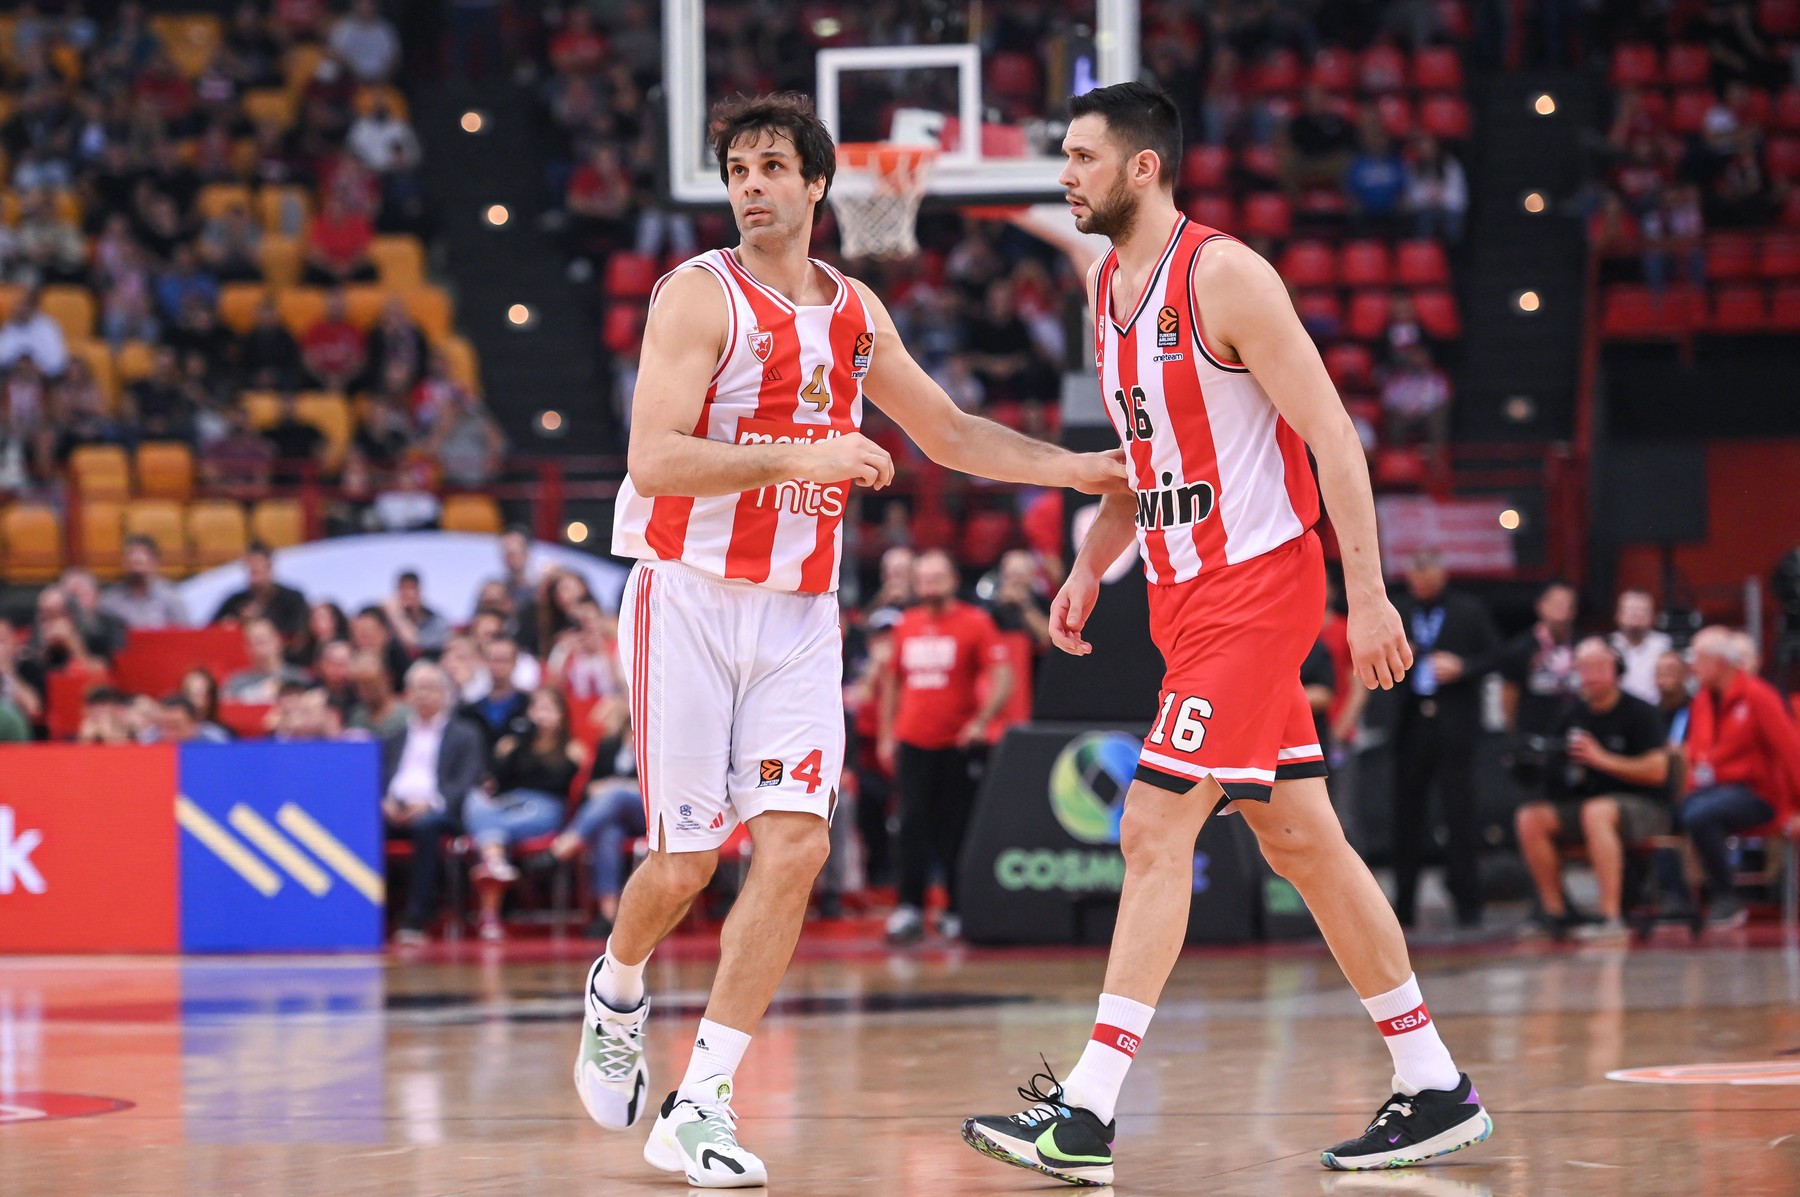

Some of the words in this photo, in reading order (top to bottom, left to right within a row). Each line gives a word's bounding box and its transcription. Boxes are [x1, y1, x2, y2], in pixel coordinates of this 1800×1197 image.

[1153, 353, 1183, 362] oneteam
[800, 365, 830, 412] 4
[1114, 386, 1154, 441] 16
[756, 480, 842, 517] mts
[1135, 471, 1213, 529] win
[1149, 692, 1214, 754] 16
[790, 749, 822, 794] 4
[1391, 1010, 1427, 1031] GSA
[1116, 1033, 1138, 1054] GS
